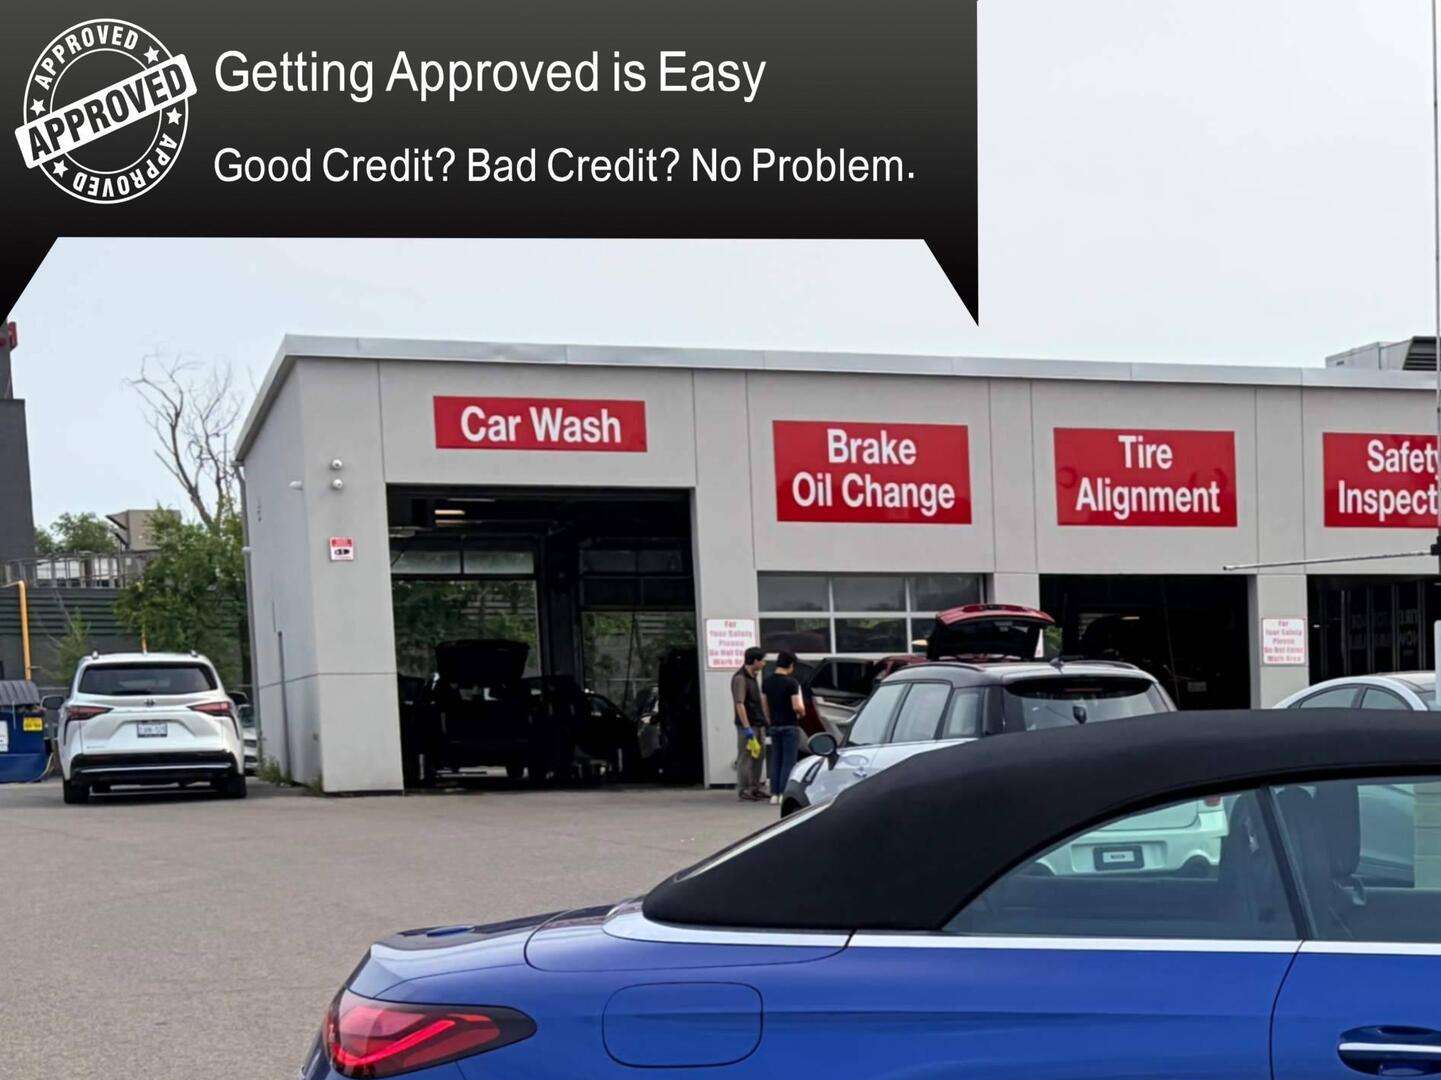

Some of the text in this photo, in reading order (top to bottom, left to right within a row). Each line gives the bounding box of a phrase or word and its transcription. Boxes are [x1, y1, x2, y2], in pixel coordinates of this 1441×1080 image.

[461, 405, 621, 443] Car Wash
[827, 428, 916, 465] Brake
[1118, 435, 1173, 469] Tire
[792, 471, 956, 517] Oil Change
[1076, 477, 1220, 520] Alignment
